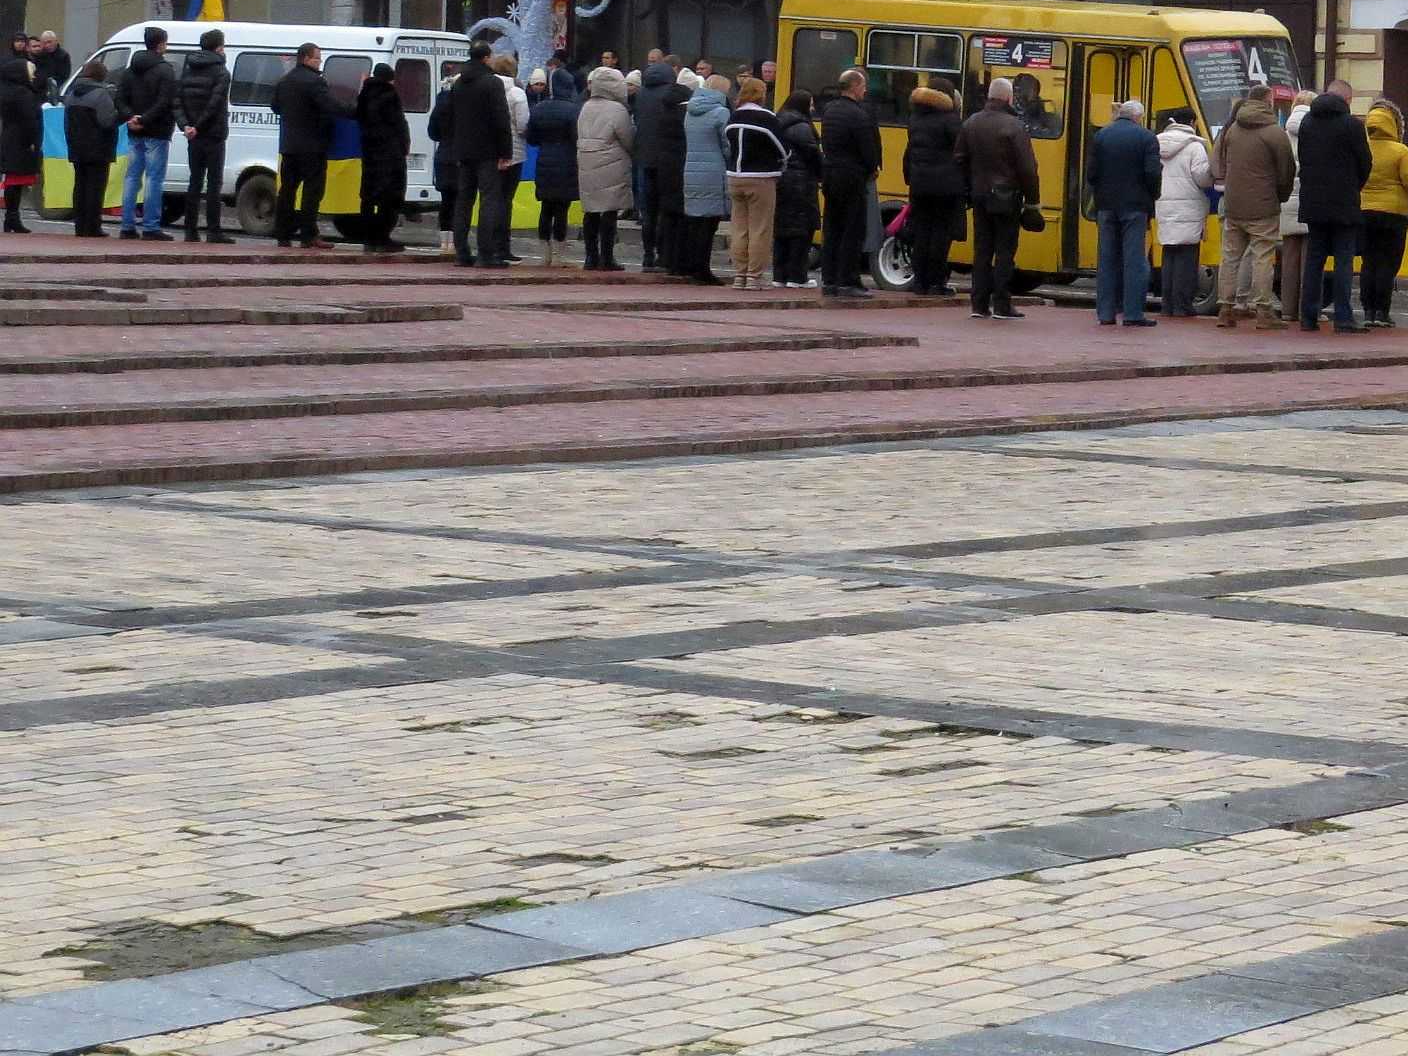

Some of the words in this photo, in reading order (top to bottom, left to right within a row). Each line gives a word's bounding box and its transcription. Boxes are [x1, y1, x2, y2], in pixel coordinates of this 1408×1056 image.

[1011, 43, 1024, 64] 4
[1248, 47, 1268, 87] 4
[228, 112, 281, 125] ИТУАЛЬ
